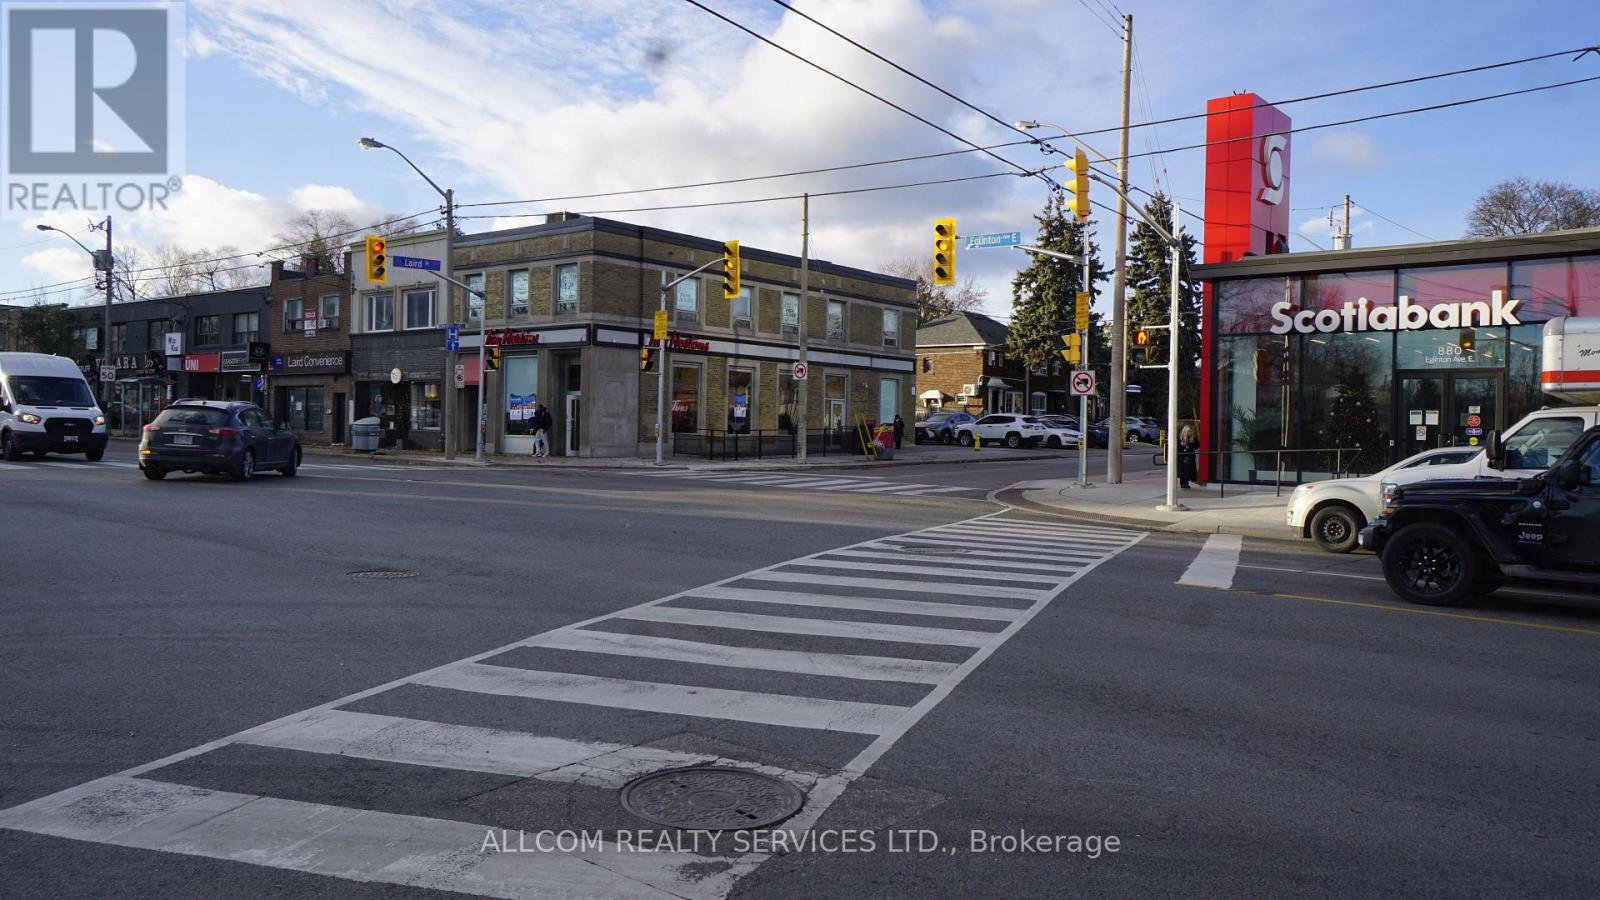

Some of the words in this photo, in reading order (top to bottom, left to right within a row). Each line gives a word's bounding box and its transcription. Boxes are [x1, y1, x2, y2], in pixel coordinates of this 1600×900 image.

[970, 236, 1001, 248] Eglinton
[1011, 232, 1017, 243] E
[404, 258, 423, 268] Laird
[1269, 289, 1521, 334] Scotiabank
[448, 330, 457, 340] H
[1438, 346, 1462, 355] 880
[184, 360, 199, 370] UNI
[287, 355, 304, 368] Laird
[304, 354, 343, 367] Convenience
[102, 371, 114, 380] 50
[1518, 531, 1543, 541] Jeep
